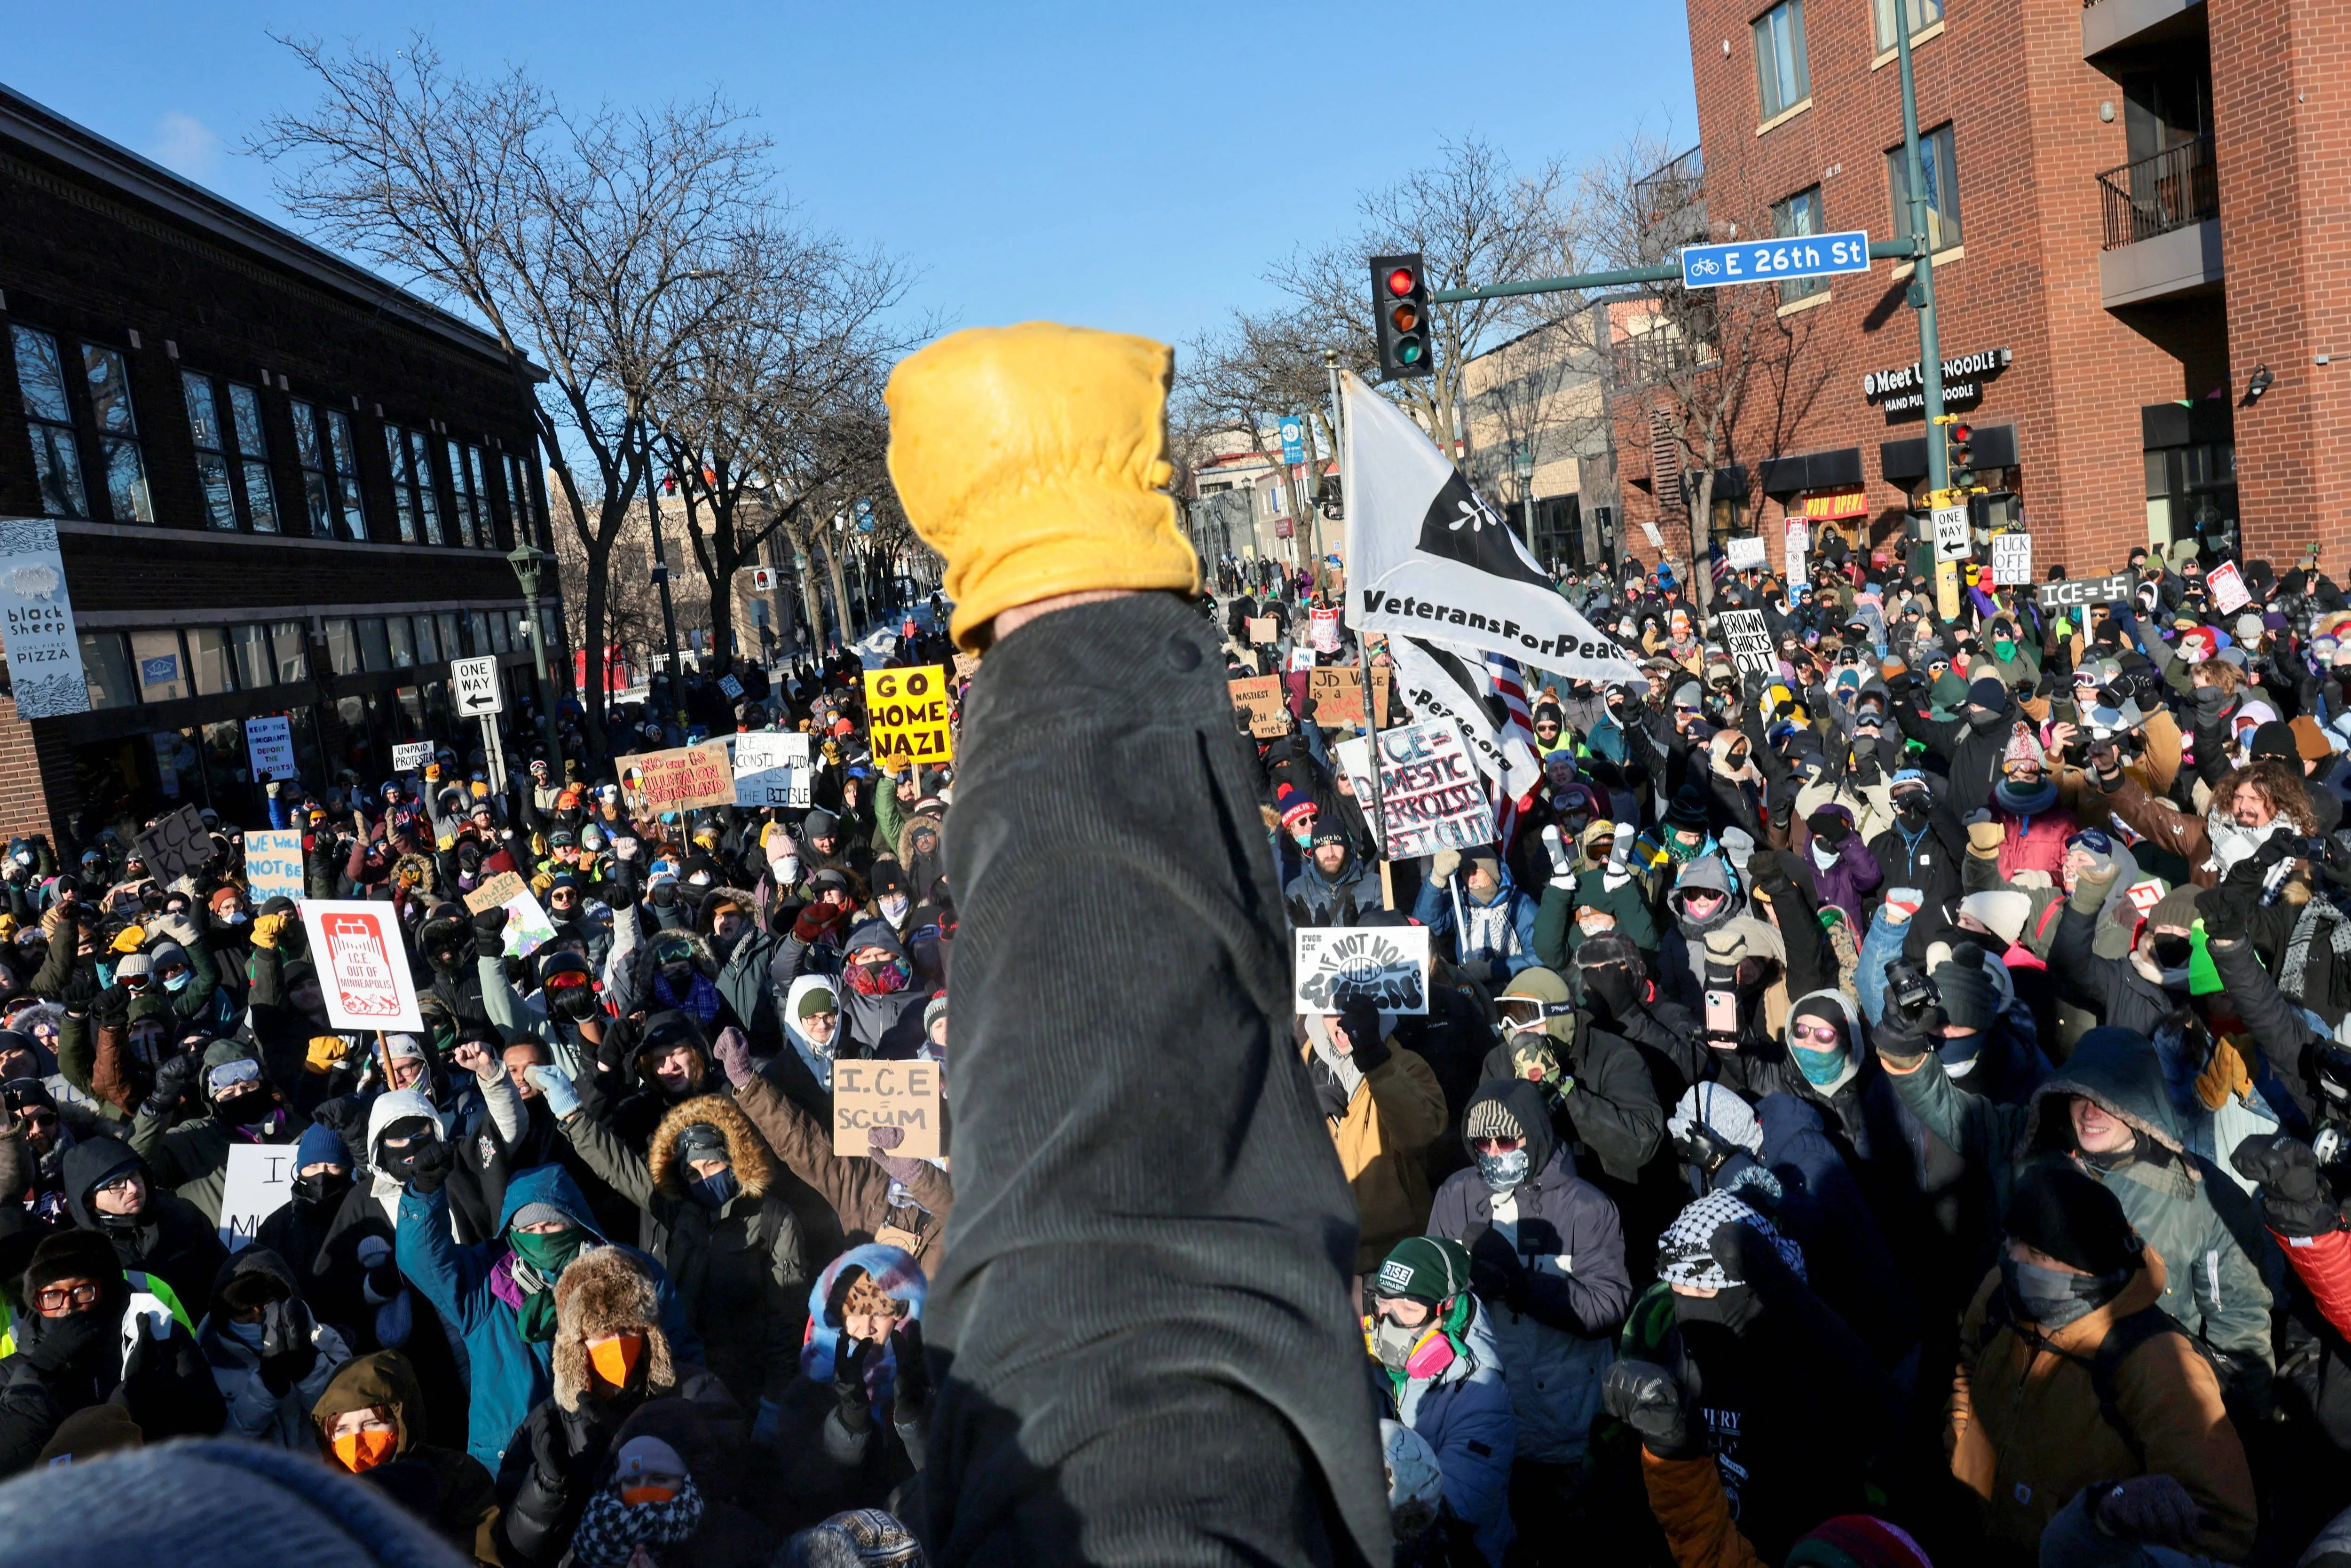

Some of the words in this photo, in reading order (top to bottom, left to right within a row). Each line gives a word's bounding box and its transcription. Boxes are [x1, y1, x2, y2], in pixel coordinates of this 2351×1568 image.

[1726, 252, 1742, 275] E
[1754, 244, 1820, 272] 26th
[1833, 241, 1862, 265] St
[1876, 370, 1912, 393] Meet
[1915, 366, 1924, 385] U
[1944, 351, 1996, 378] NOODLE
[1885, 396, 1908, 412] HAND
[1909, 392, 1924, 408] PUL
[1806, 497, 1830, 516] NOW
[1834, 493, 1864, 515] OPEN!
[1939, 511, 1961, 525] ONE
[1940, 525, 1962, 538] WAY
[1731, 540, 1759, 552] YOU
[1995, 536, 2029, 553] FUCK
[1994, 553, 2028, 568] OFF
[1994, 568, 2029, 583] ICE
[8, 605, 63, 622] black
[11, 622, 65, 635] sheep
[1722, 613, 1765, 635] BROWN
[1729, 634, 1771, 653] SHIRTS
[17, 648, 70, 664] PIZZA
[1299, 653, 1310, 662] MN
[1736, 651, 1774, 674] OUT
[460, 662, 488, 677] ONE
[1315, 670, 1340, 686] JD
[1350, 671, 1384, 686] VACE
[461, 677, 489, 692] WAY
[719, 675, 734, 688] END
[724, 681, 742, 694] ICE
[876, 673, 928, 697] GO
[1248, 679, 1279, 690] Noem
[1313, 688, 1323, 699] is
[1334, 689, 1341, 699] a
[868, 701, 944, 727] HOME
[249, 725, 268, 733] KEEP
[257, 746, 284, 755] DEPORT
[398, 743, 428, 755] UNPAID
[736, 735, 756, 751] ICE
[875, 730, 945, 758] NAZI
[395, 752, 434, 768] PROTESTER
[641, 756, 664, 773] NO
[688, 752, 706, 765] IS
[643, 768, 697, 791] ILLEGAL
[695, 764, 719, 780] ON
[764, 768, 783, 781] OR
[645, 784, 691, 805] STOLEN
[688, 779, 726, 797] LAND
[736, 788, 762, 803] THE
[766, 787, 809, 804] BIBLE
[139, 805, 202, 859] ICE
[245, 834, 269, 853] WE
[272, 835, 302, 850] WILL
[157, 831, 211, 883] KYS
[247, 859, 284, 877] NOT
[285, 863, 302, 878] BE
[473, 883, 499, 906] What
[497, 874, 517, 890] ICE
[487, 889, 514, 906] SEES
[1302, 934, 1322, 943] FUCK
[348, 953, 371, 964] I.C.E.
[1318, 953, 1339, 972] IF
[1332, 933, 1369, 961] NOT
[1371, 935, 1411, 974] NOW
[347, 966, 364, 977] OUT
[367, 967, 378, 977] OF
[1340, 958, 1382, 982] THEN
[340, 978, 392, 989] MINNEAPOLIS
[838, 1068, 931, 1097] I.C.E
[48, 1083, 90, 1103] IC
[1384, 1264, 1409, 1281] RISE
[1380, 1278, 1406, 1292] CANNABIS
